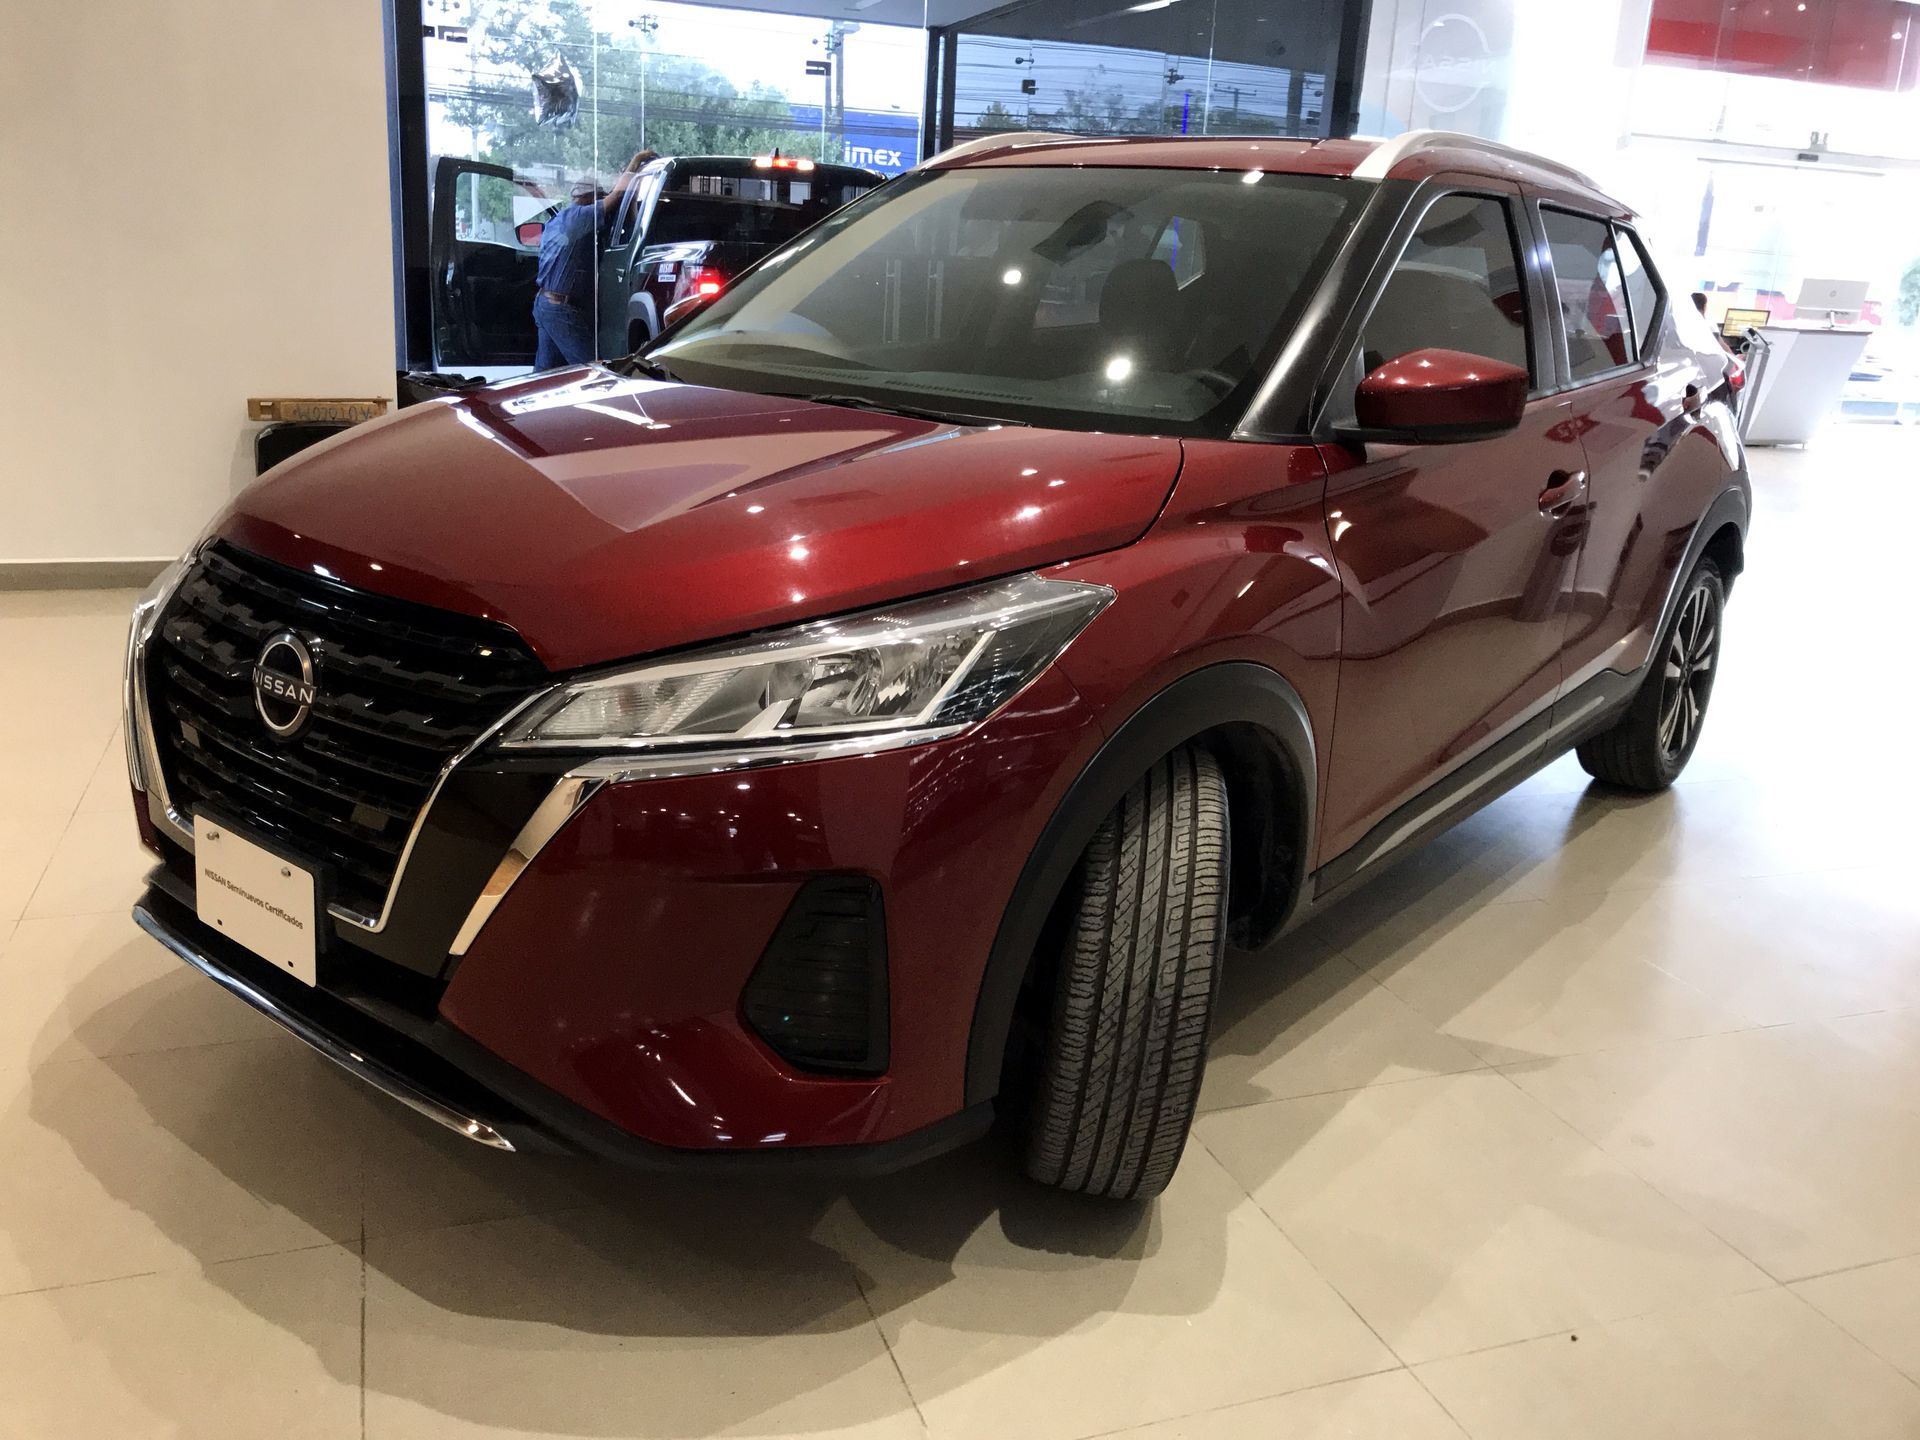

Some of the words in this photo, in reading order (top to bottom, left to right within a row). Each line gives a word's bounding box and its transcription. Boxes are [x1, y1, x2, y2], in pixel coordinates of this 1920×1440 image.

[252, 666, 314, 704] NISSAN
[204, 867, 227, 887] NISSAN
[226, 880, 265, 908] Seminuevos
[264, 902, 304, 930] Certificados
